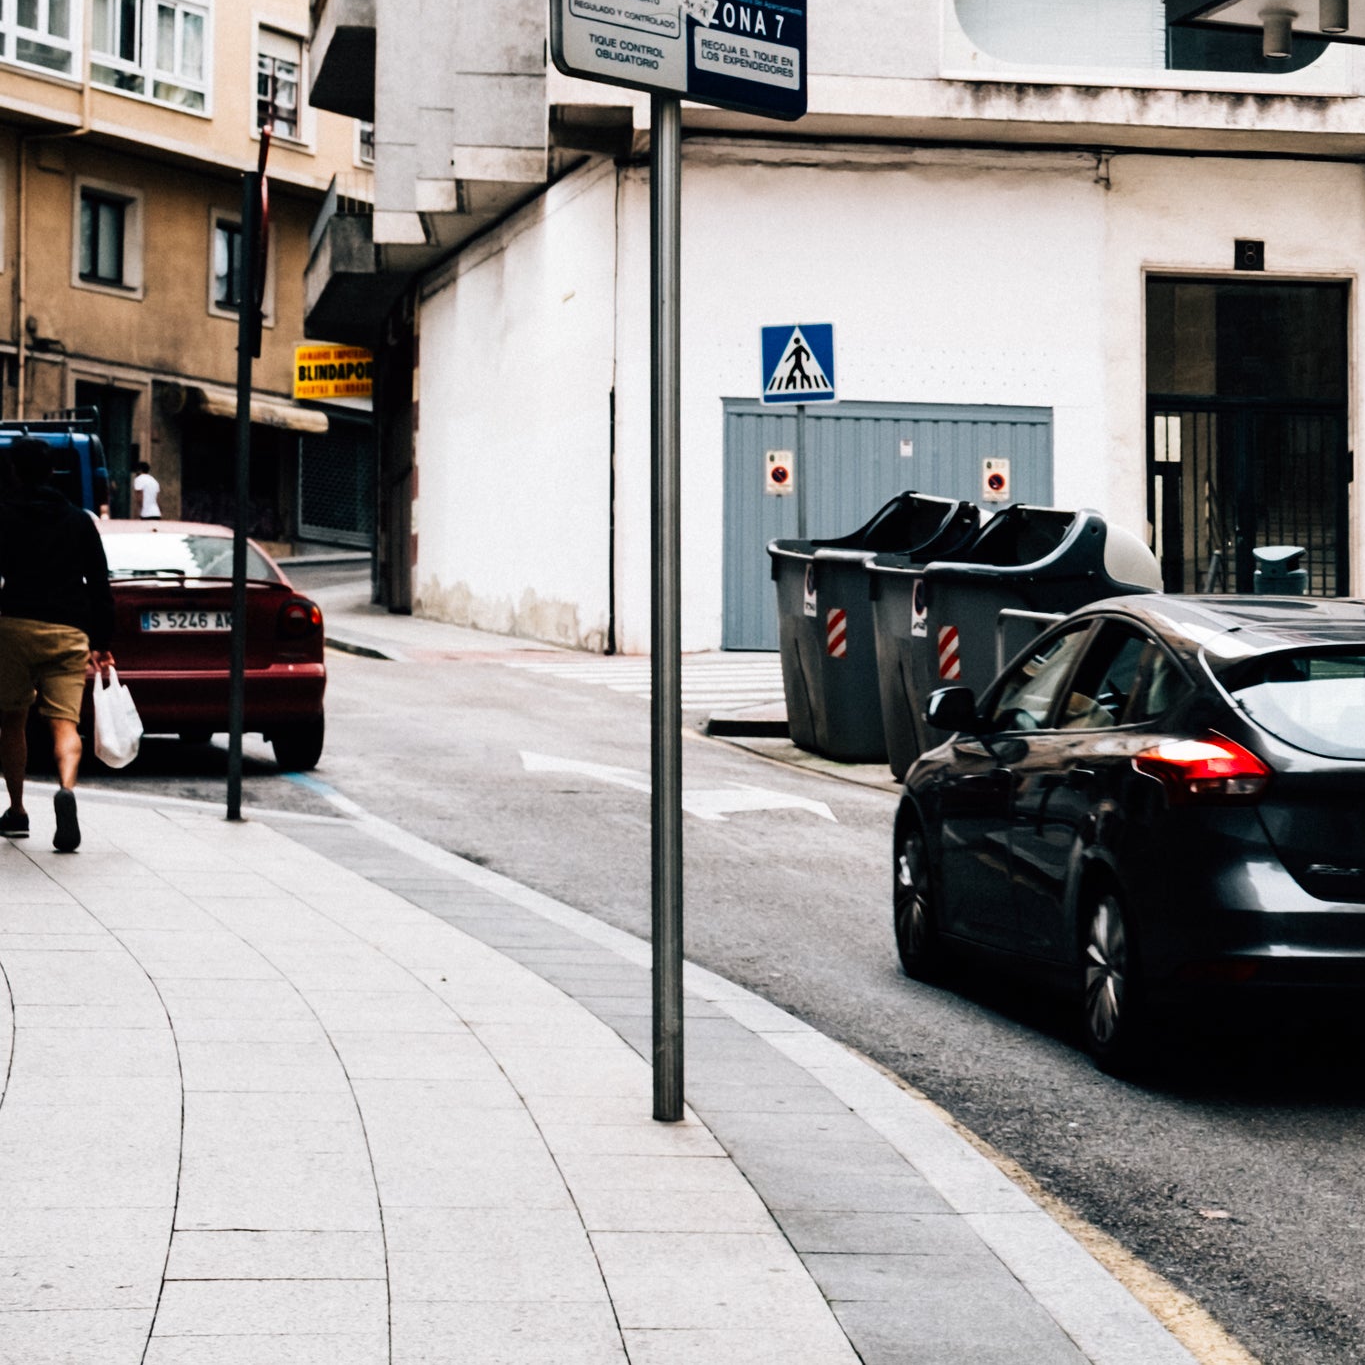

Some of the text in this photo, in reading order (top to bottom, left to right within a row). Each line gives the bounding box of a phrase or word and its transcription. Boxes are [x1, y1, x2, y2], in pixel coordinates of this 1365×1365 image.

[574, 0, 615, 16] REGULADO
[624, 11, 676, 30] CONTROLADO
[775, 14, 784, 39] 7
[589, 33, 664, 59] TIQUE CONTROL
[701, 39, 793, 67] RECOJA EL TIQUE EN
[595, 48, 659, 70] OBLIGATORIO
[701, 50, 794, 78] LOS EXPENDEDORES
[1244, 243, 1257, 265] 8
[151, 612, 161, 628] S
[167, 612, 208, 628] 5246
